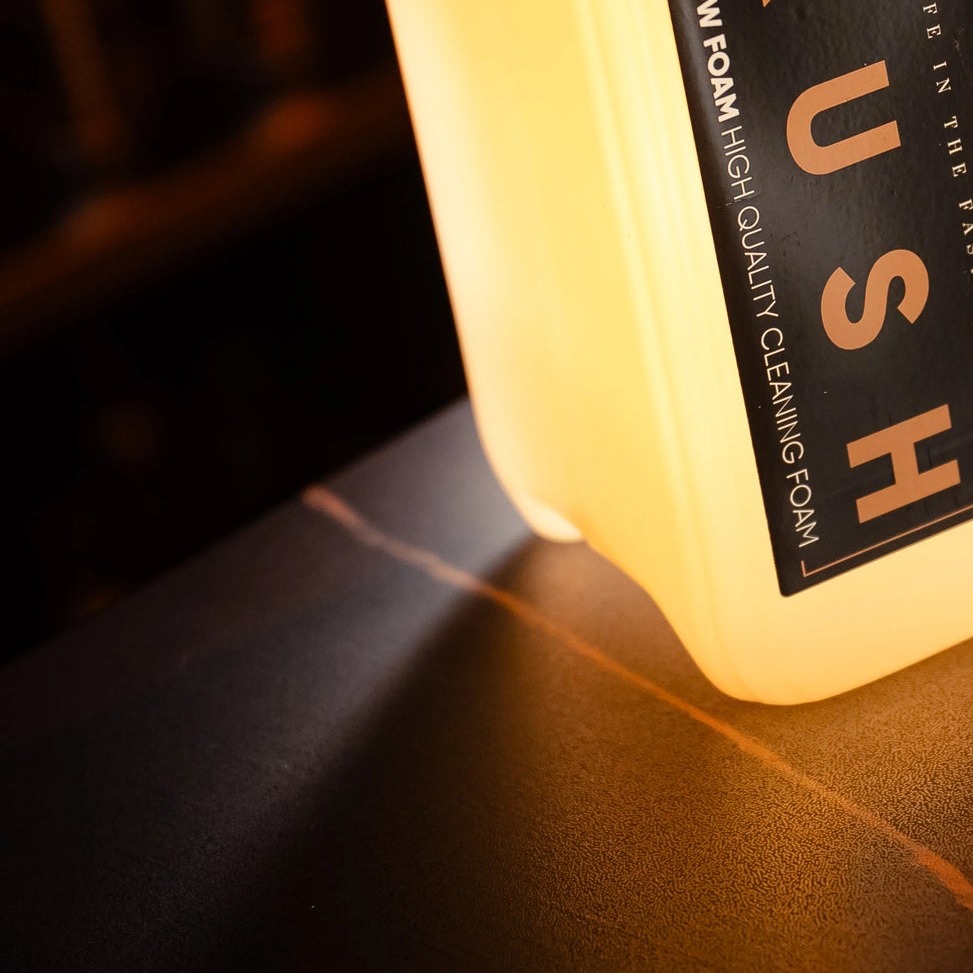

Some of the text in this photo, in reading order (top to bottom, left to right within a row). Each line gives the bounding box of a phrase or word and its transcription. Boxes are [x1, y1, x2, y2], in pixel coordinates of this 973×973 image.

[703, 33, 740, 123] FOAM
[933, 61, 951, 93] IN
[944, 115, 967, 177] THE
[720, 125, 755, 203] HIGH
[737, 205, 779, 317] QUALITY
[760, 327, 804, 464] CLEANING
[786, 468, 819, 548] FOAM
